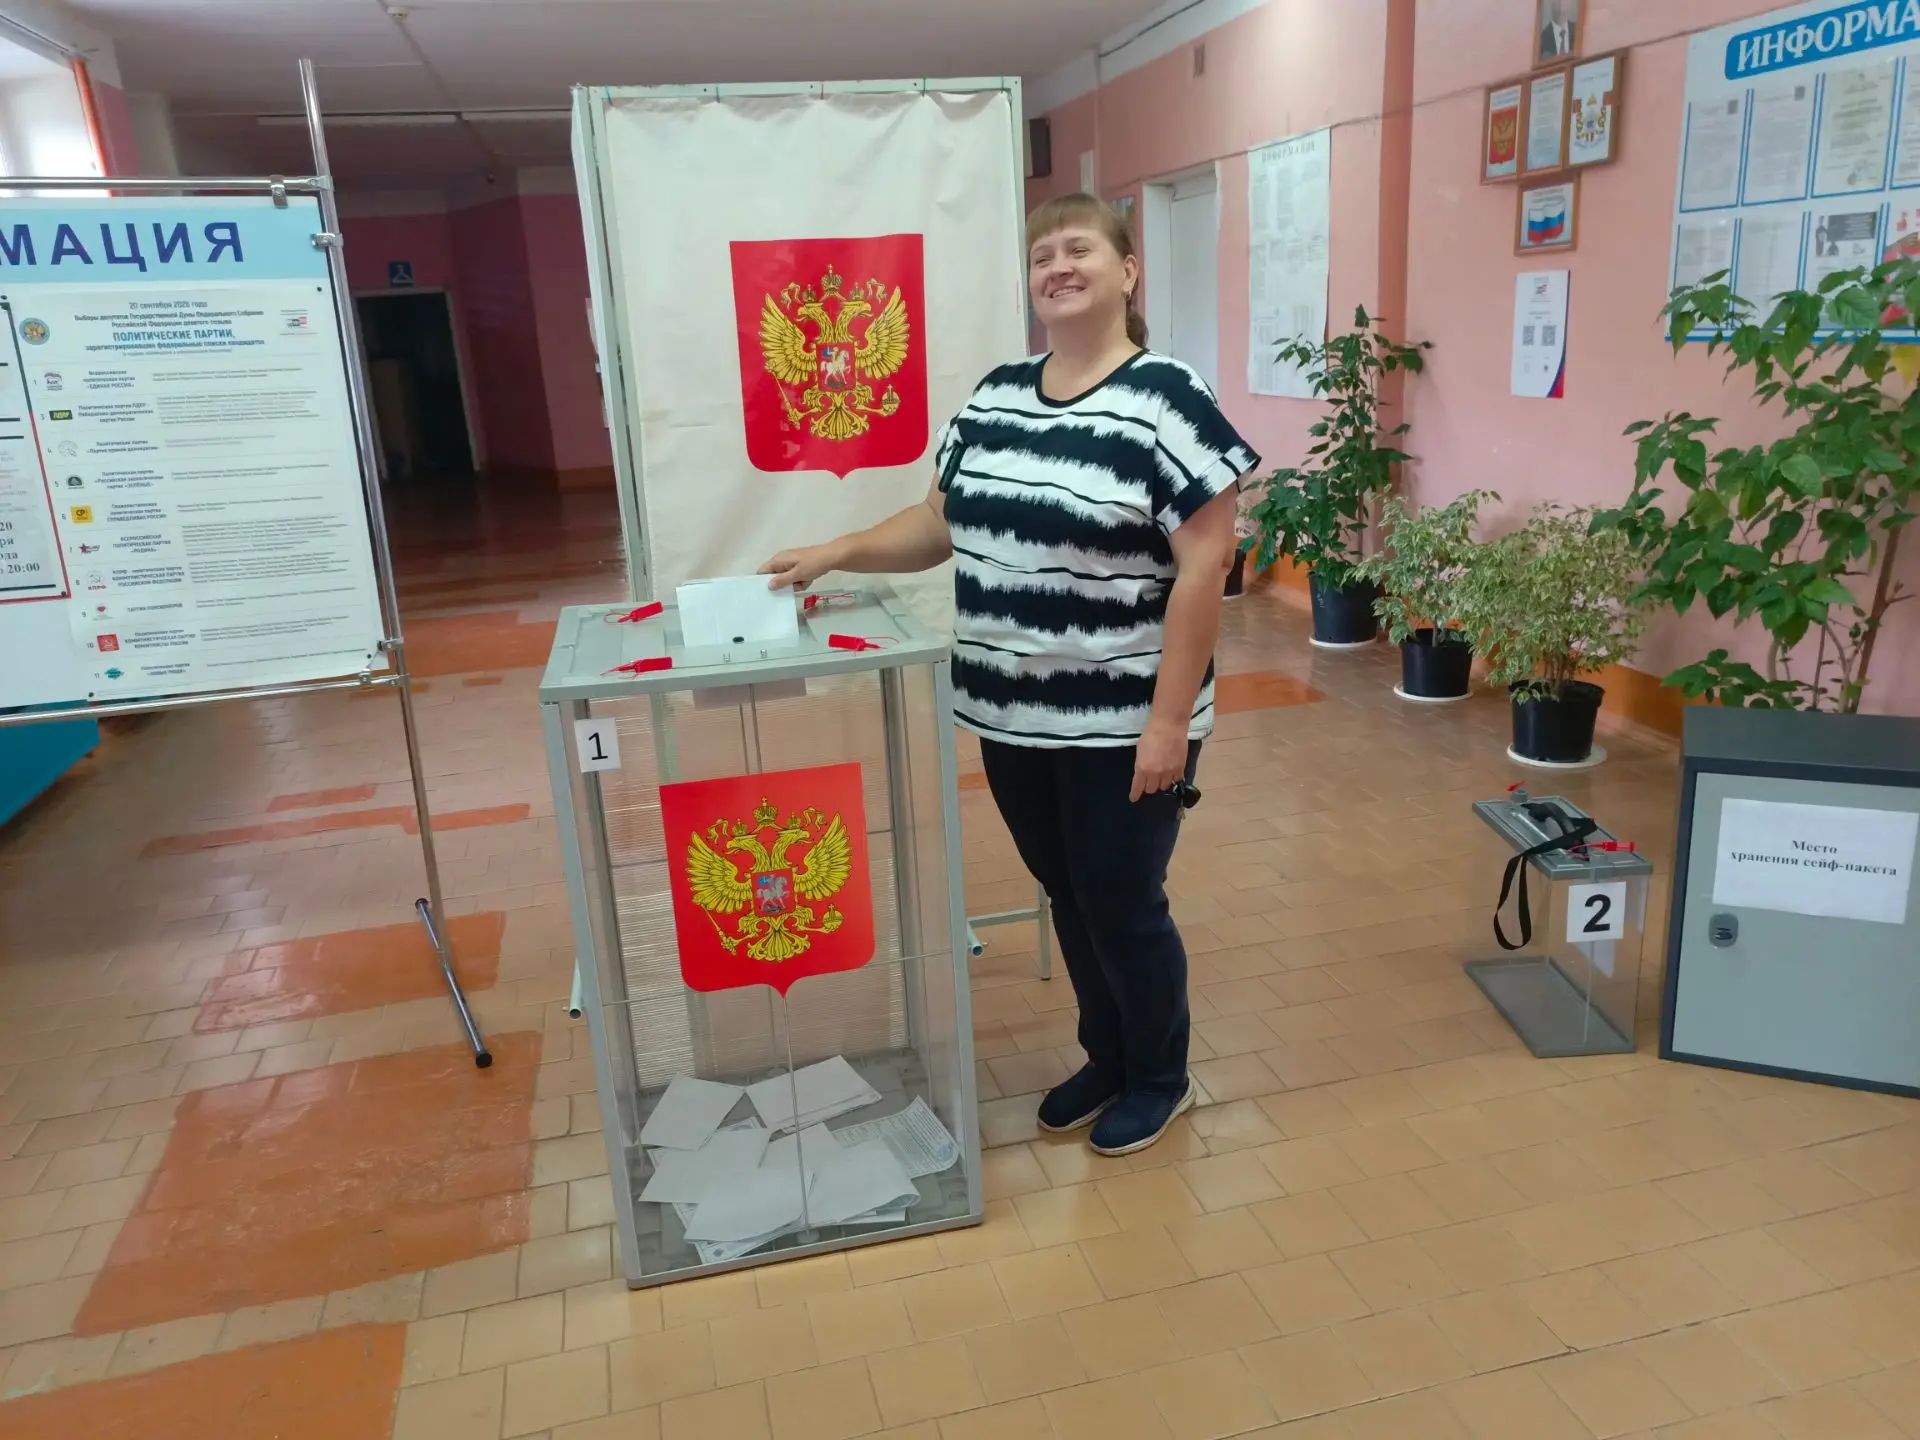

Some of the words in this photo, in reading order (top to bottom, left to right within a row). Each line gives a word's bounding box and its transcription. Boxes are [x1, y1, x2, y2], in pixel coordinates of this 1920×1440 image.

[1737, 0, 1920, 72] ИНФОРМА
[0, 222, 244, 272] МАЦИЯ
[113, 329, 192, 342] ПОЛИТИЧЕСКИЕ
[8, 562, 40, 574] 20:00
[588, 731, 608, 760] 1
[1792, 839, 1838, 854] Место
[1730, 851, 1799, 865] хранения
[1803, 858, 1897, 876] сейф-пакета
[1582, 893, 1612, 932] 2
